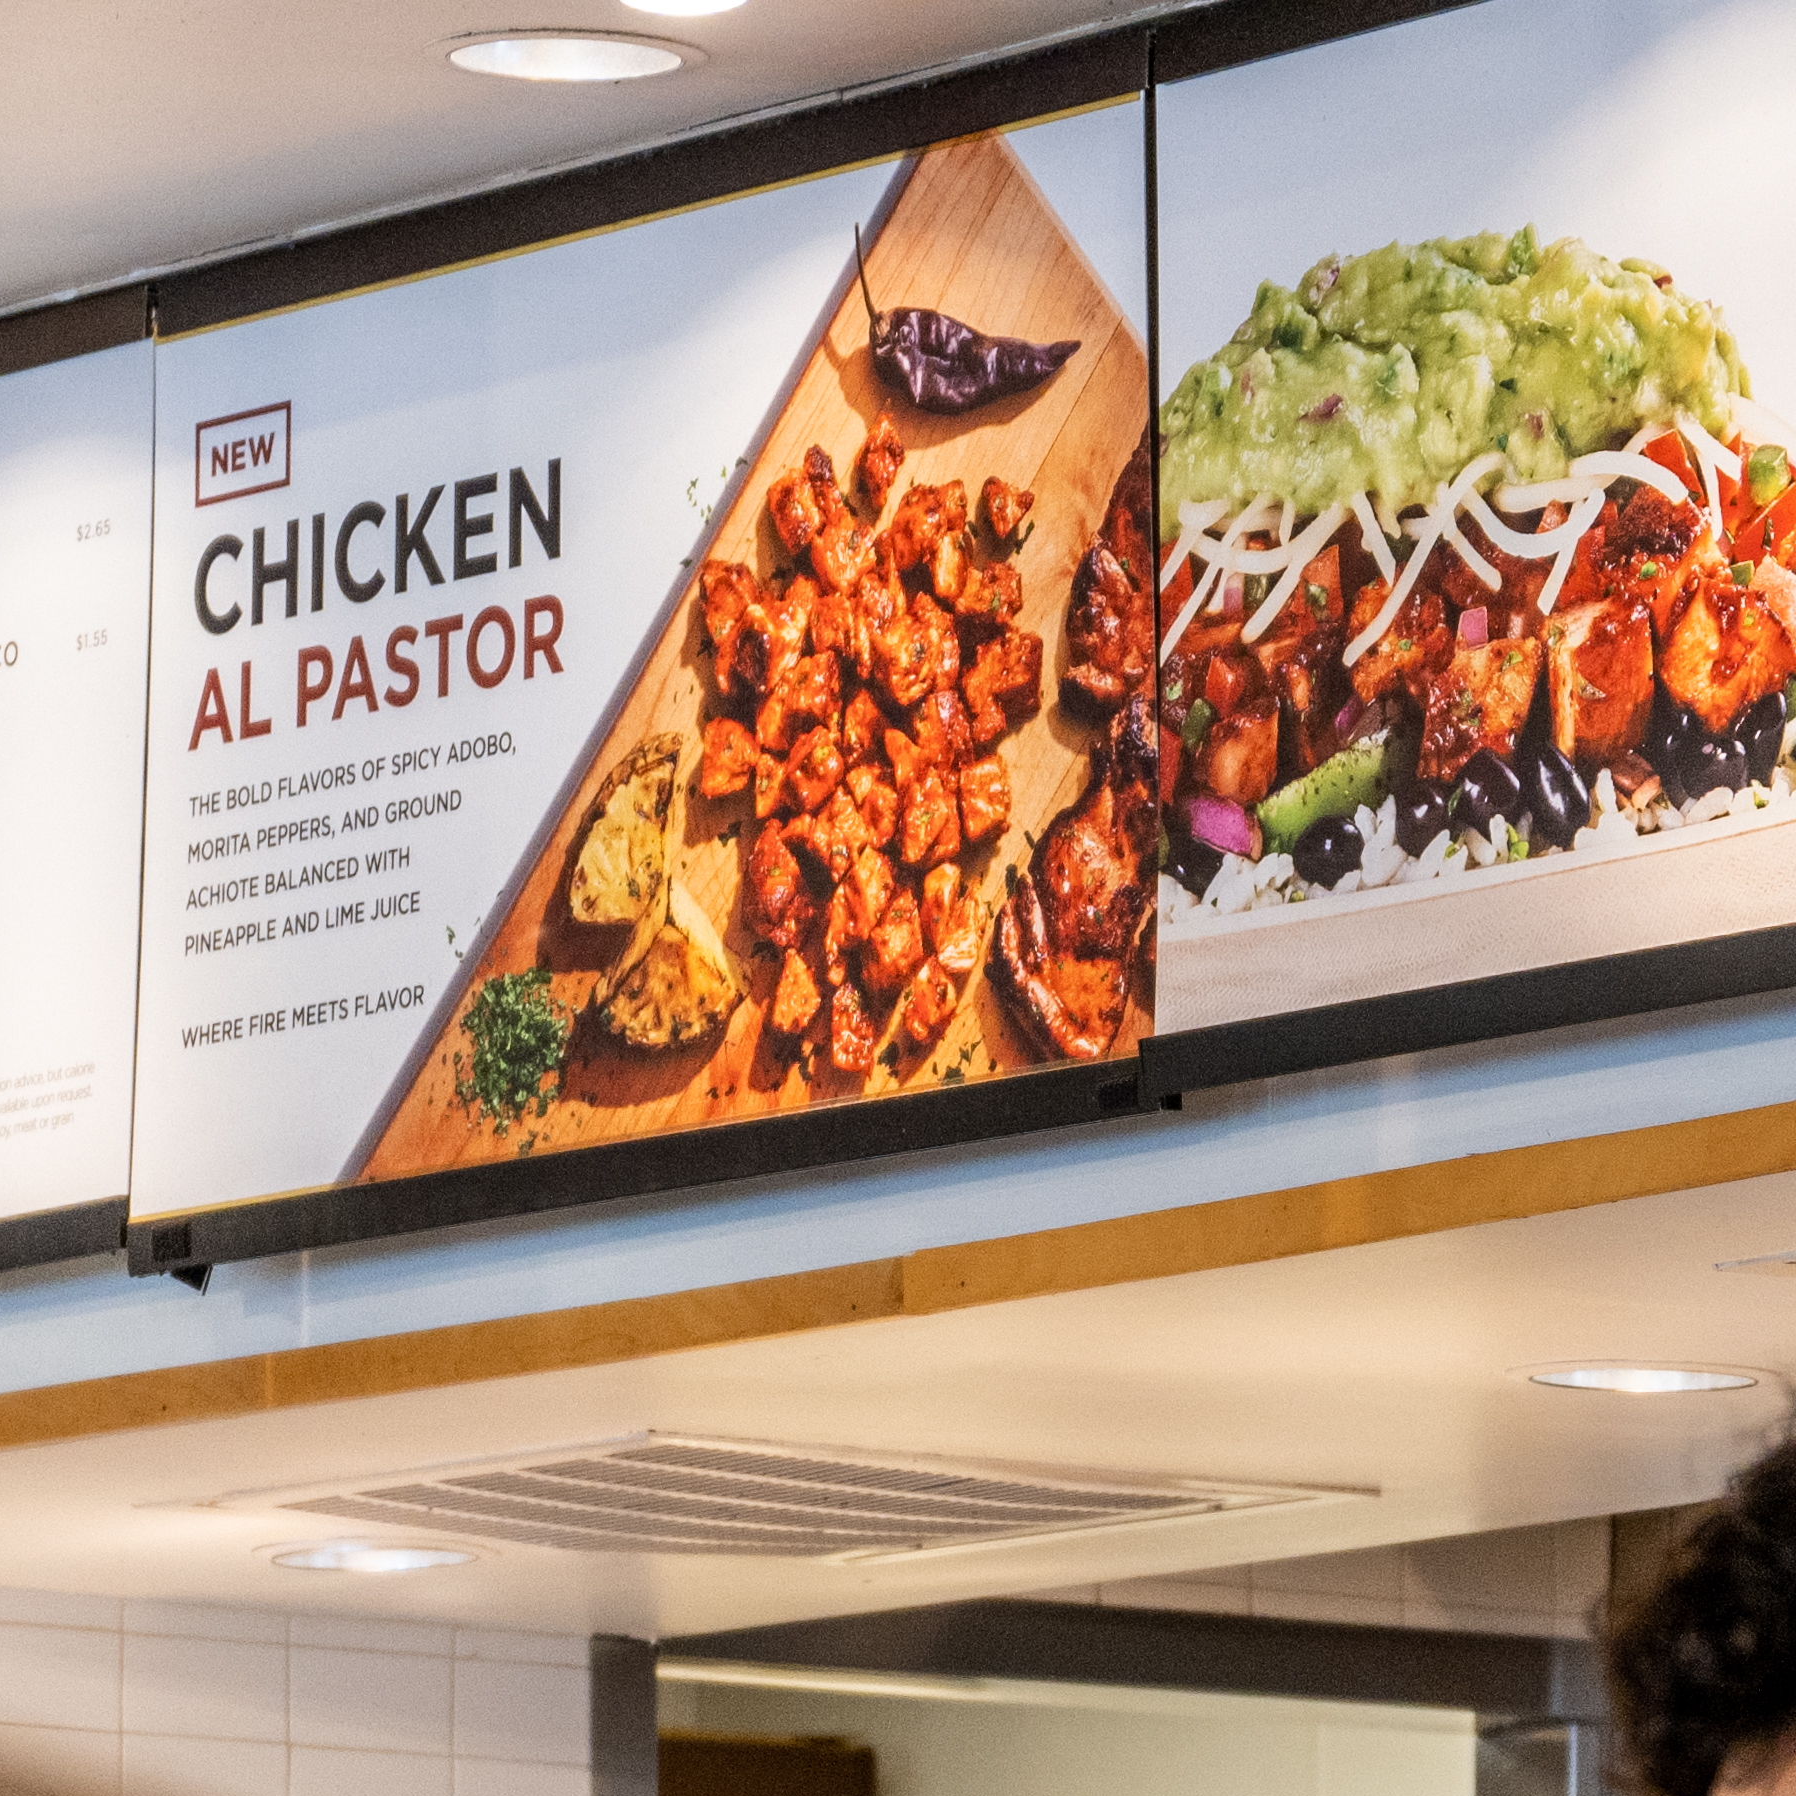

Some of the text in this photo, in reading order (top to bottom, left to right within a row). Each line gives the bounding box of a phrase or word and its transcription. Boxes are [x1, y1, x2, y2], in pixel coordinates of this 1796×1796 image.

[212, 432, 275, 476] NEW
[195, 458, 561, 635] CHICKEN
[189, 595, 563, 751] AL PASTOR
[190, 731, 516, 816] THE BOLD FLAVORS OF SPICY ADOBO,
[188, 789, 462, 863] MORITA PEPPERS, AND GROUND
[186, 847, 410, 910] ACHIOTE BALANCED WITH
[185, 891, 420, 955] PINEAPPLE AND LIME JUICE
[182, 984, 424, 1048] WHERE FIRE MEETS FLAVOR
